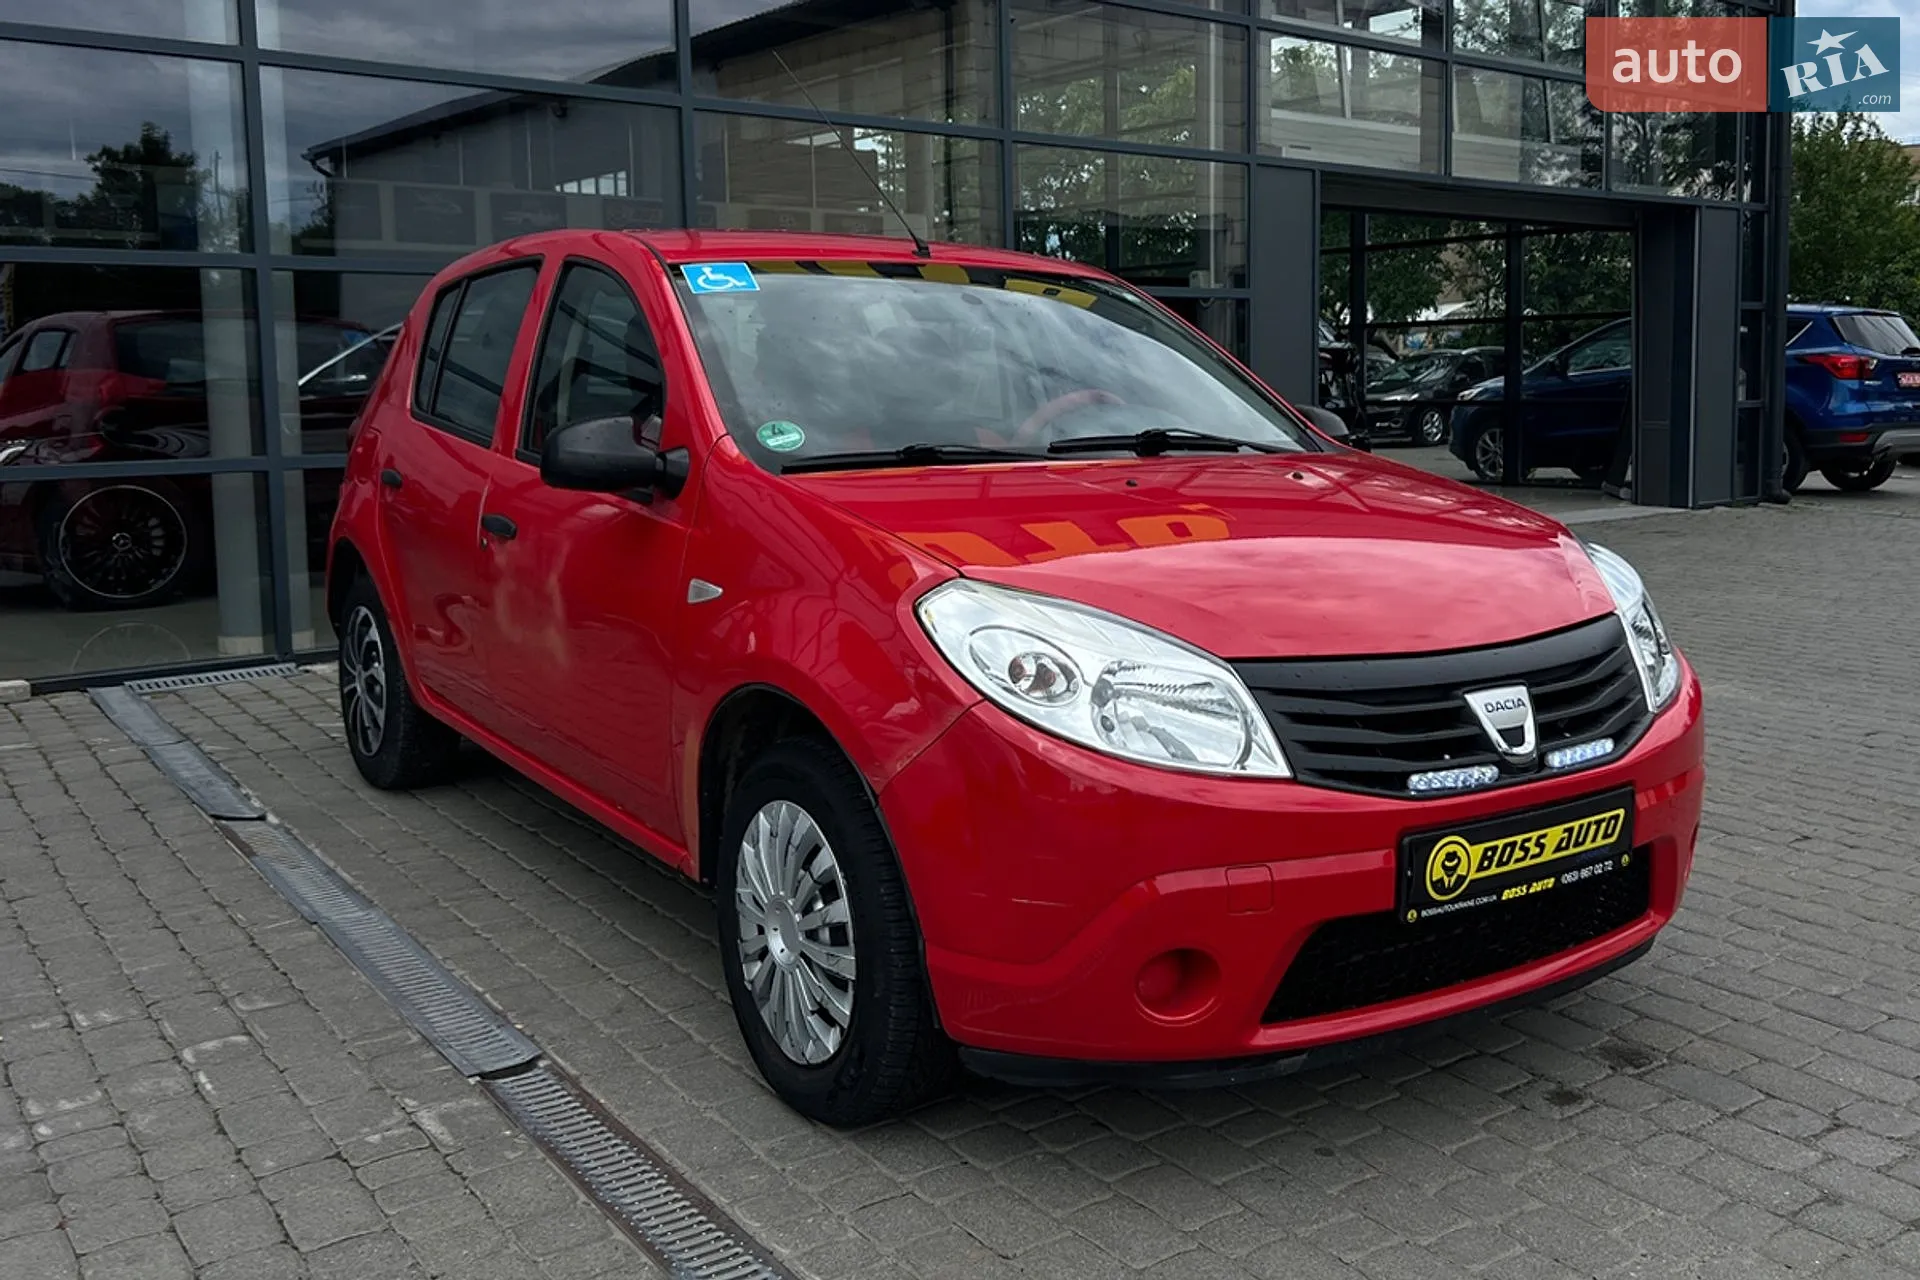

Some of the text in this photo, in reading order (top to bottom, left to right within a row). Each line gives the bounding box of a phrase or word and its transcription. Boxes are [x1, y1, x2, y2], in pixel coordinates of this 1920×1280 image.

[771, 423, 785, 435] 4
[1483, 697, 1527, 713] DACIA
[1475, 813, 1622, 874] BOSS AUTO
[1501, 884, 1527, 901] BOSS
[1528, 877, 1556, 894] AUTO
